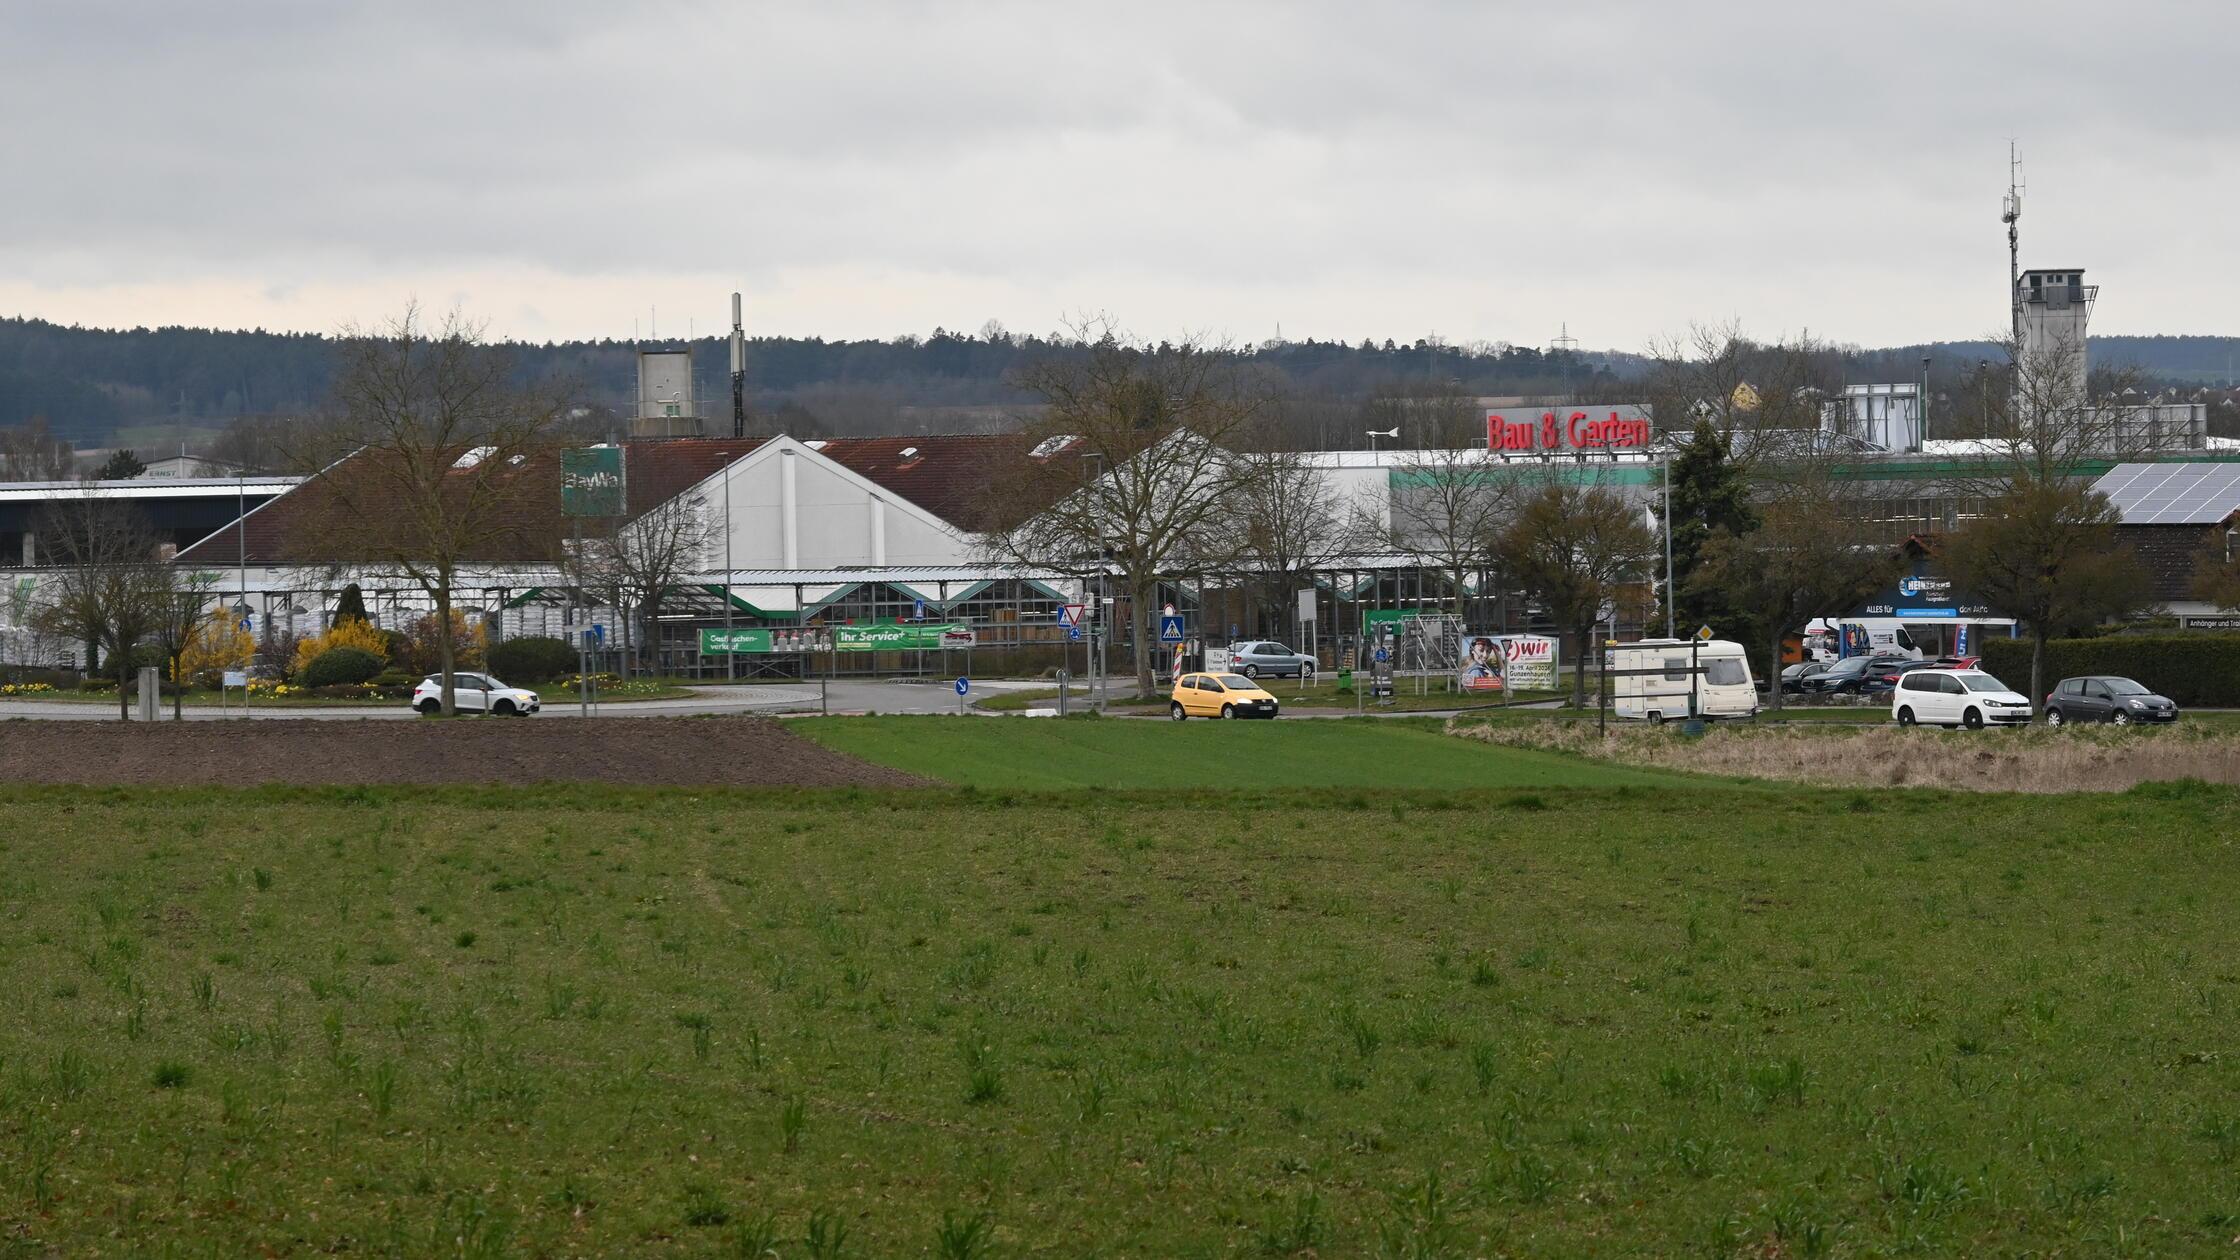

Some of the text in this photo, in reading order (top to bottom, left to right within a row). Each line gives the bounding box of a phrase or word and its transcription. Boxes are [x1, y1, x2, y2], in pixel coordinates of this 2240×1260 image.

[1488, 411, 1649, 449] Bau & Garten
[1866, 605, 1883, 613] ALLES
[1884, 605, 1894, 613] für
[840, 632, 857, 641] Ihr
